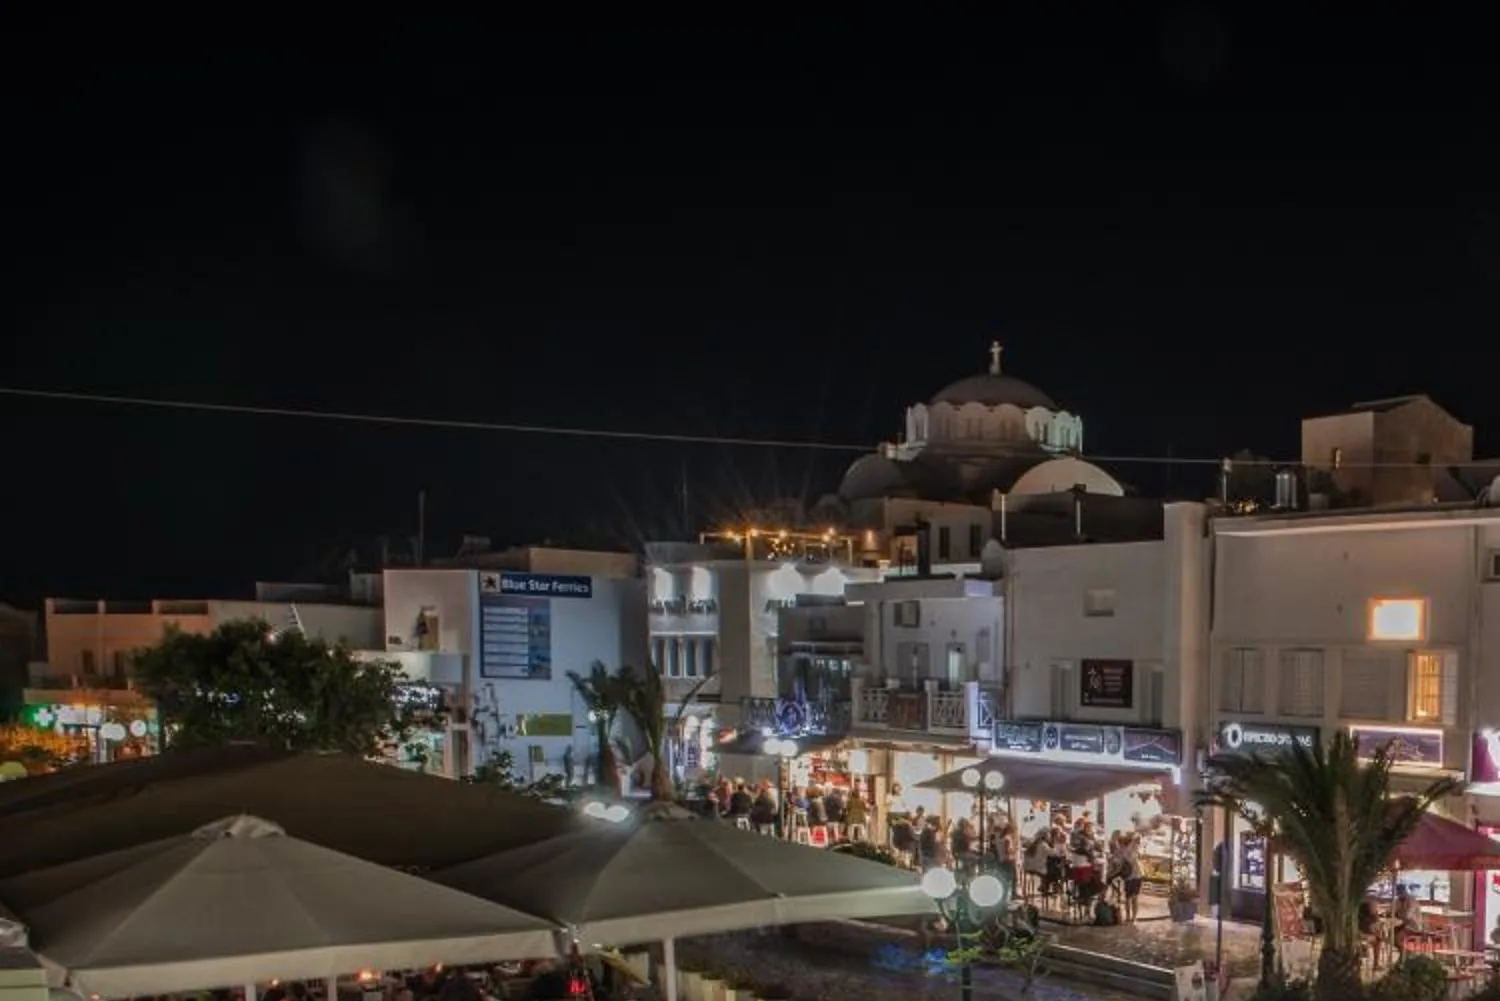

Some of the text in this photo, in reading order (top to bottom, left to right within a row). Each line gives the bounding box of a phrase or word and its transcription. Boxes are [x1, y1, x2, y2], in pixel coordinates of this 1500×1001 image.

[502, 578, 589, 594] Blue Star Ferries
